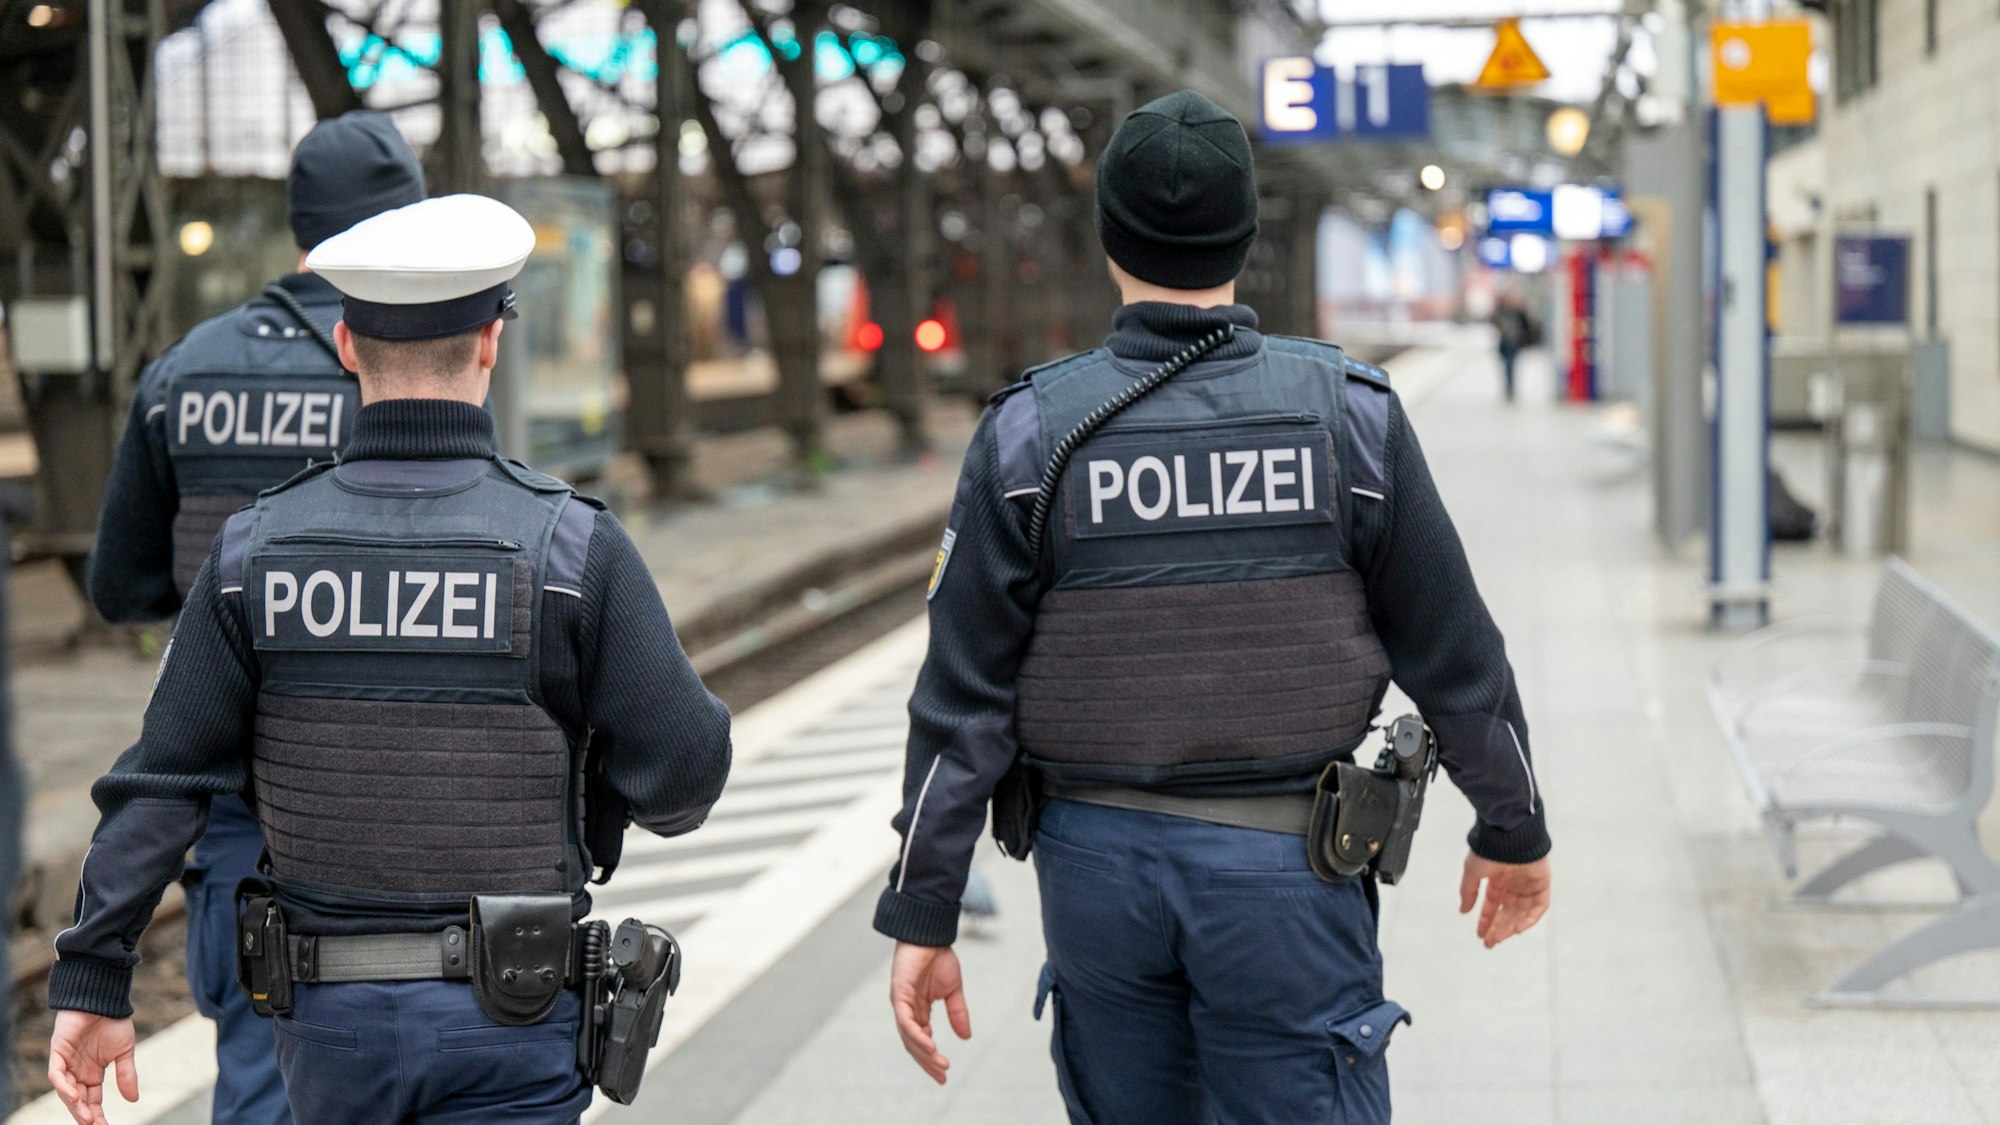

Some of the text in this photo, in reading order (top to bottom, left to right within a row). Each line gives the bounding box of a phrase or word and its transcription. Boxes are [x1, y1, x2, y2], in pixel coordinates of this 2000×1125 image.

[1264, 57, 1317, 131] E
[179, 391, 344, 447] POLIZEI
[1088, 447, 1315, 524] POLIZEI
[265, 569, 498, 639] POLIZEI
